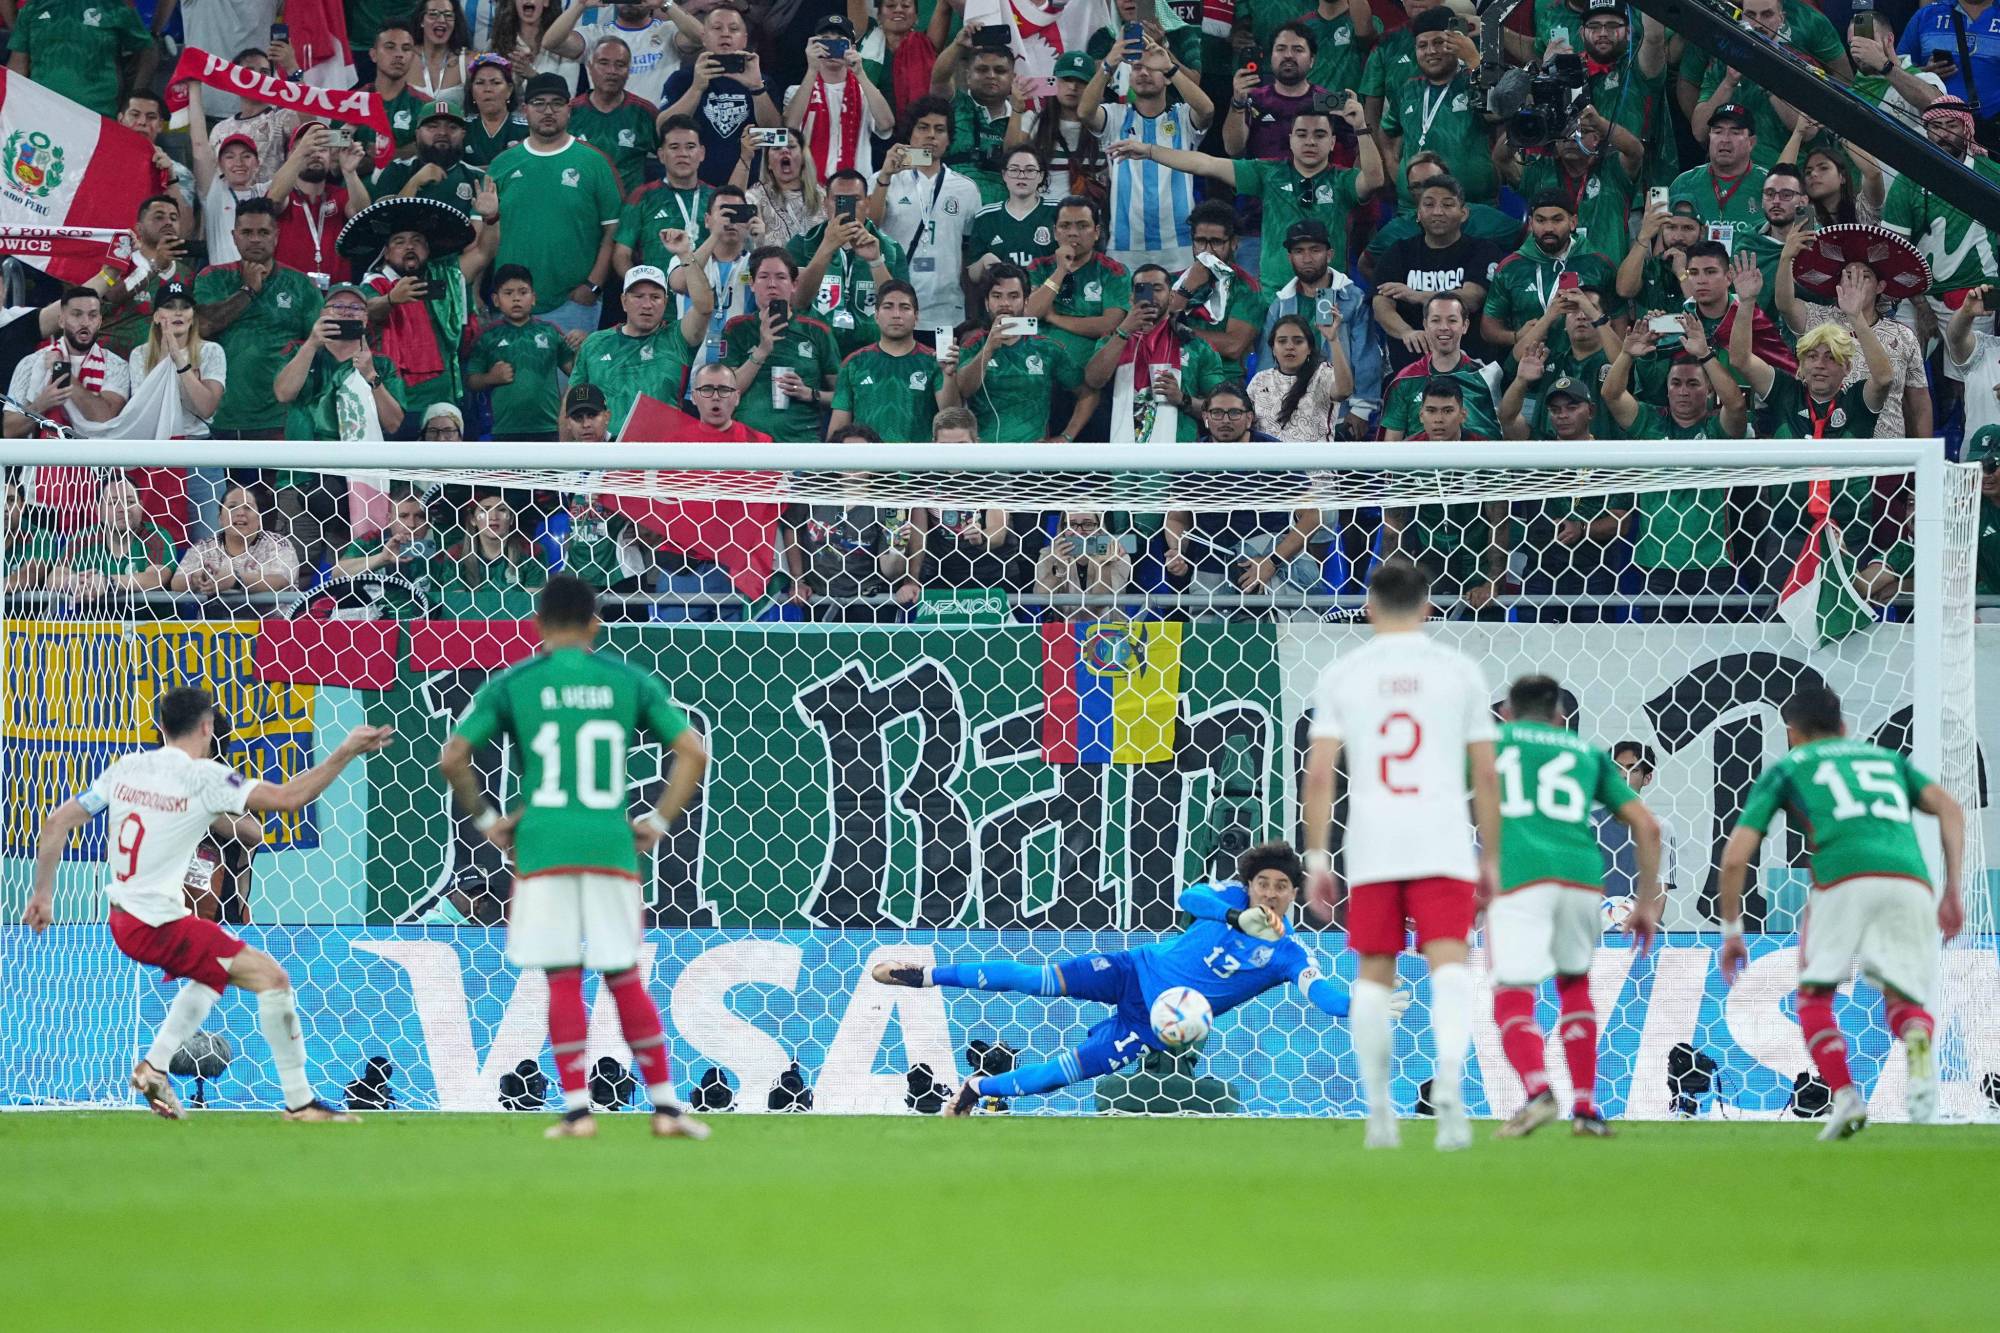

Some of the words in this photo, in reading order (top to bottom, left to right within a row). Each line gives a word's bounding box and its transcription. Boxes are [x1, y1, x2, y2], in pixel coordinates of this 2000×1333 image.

[203, 53, 371, 117] POLSKA
[4, 190, 23, 204] amo
[24, 197, 50, 217] PERÚ
[0, 238, 52, 252] WICE
[917, 597, 1002, 617] MEXICO
[531, 719, 626, 810] 10
[1379, 711, 1422, 794] 2
[1495, 745, 1585, 823] 16
[113, 783, 190, 813] LEWANDOWSKI
[1812, 759, 1911, 825] 15
[116, 811, 146, 883] 9
[1203, 946, 1242, 979] 13
[352, 938, 961, 1112] VISA
